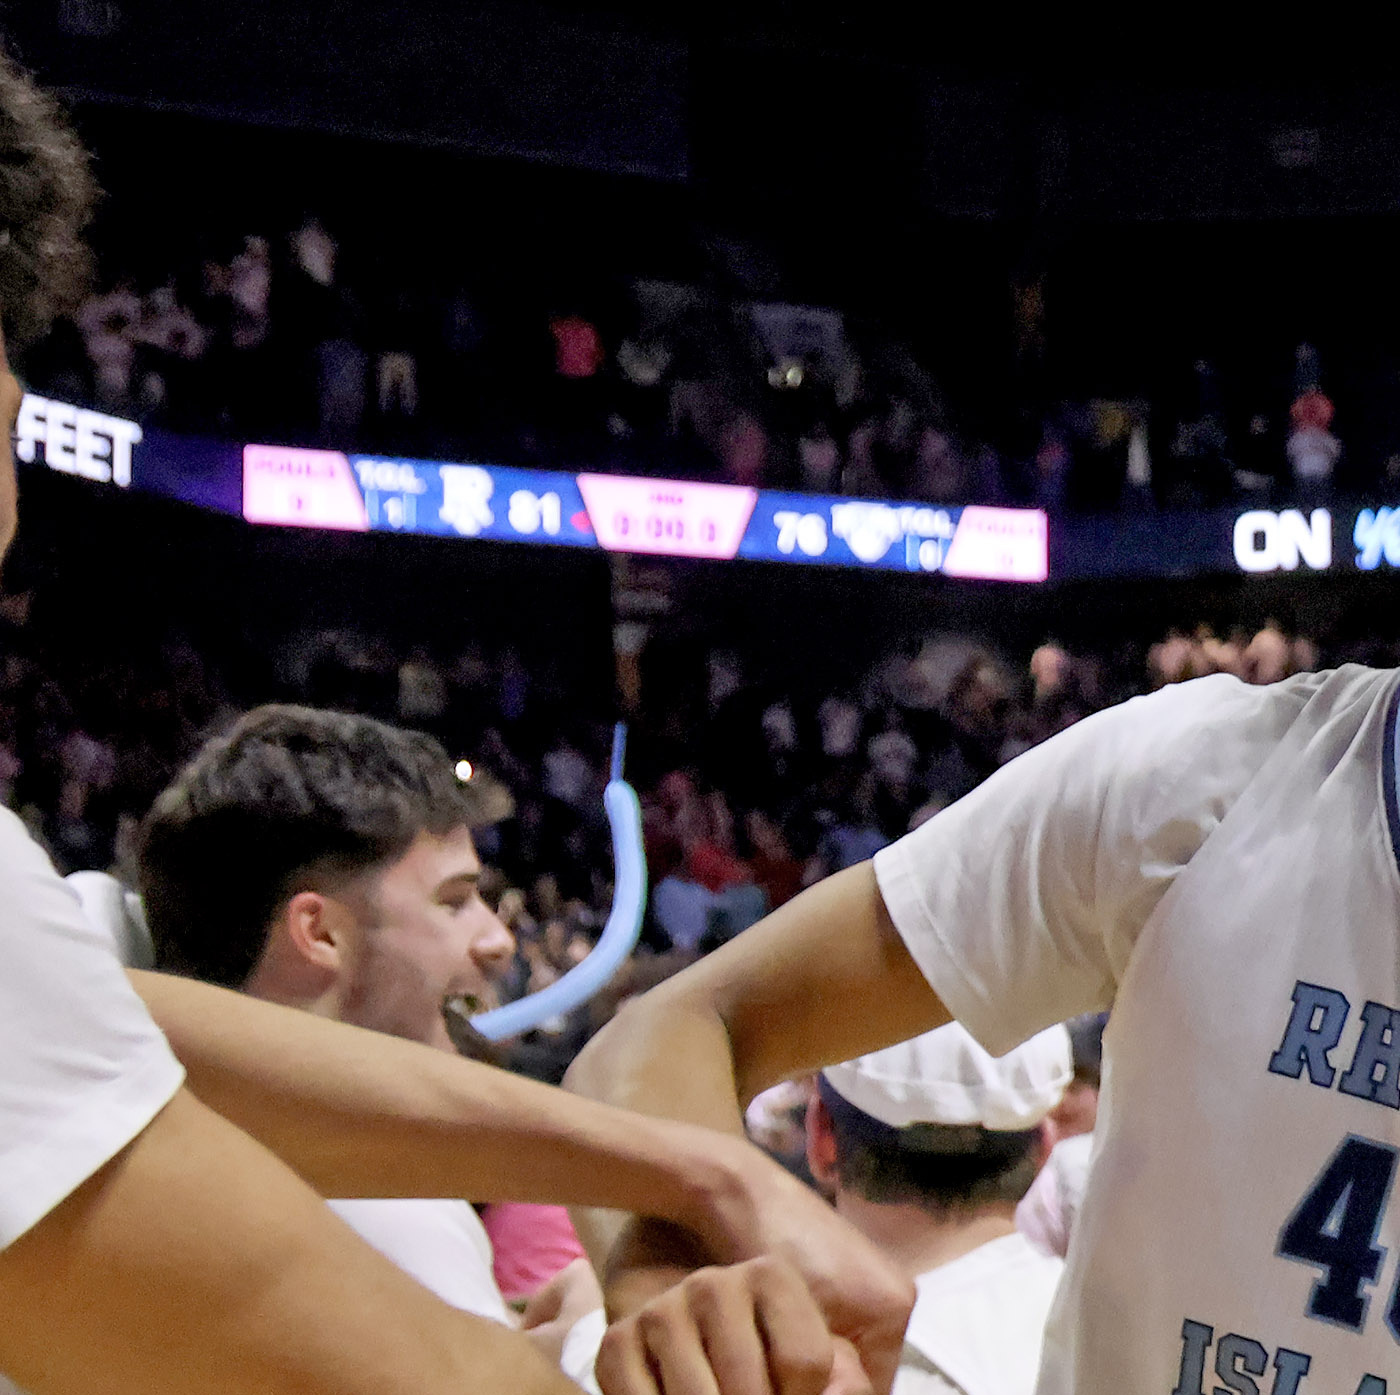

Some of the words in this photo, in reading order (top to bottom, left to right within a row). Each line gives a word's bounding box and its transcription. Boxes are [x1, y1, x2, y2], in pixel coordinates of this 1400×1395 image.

[17, 393, 144, 487] FEET
[508, 490, 561, 535] 81
[774, 510, 828, 556] 76
[1233, 507, 1332, 572] ON
